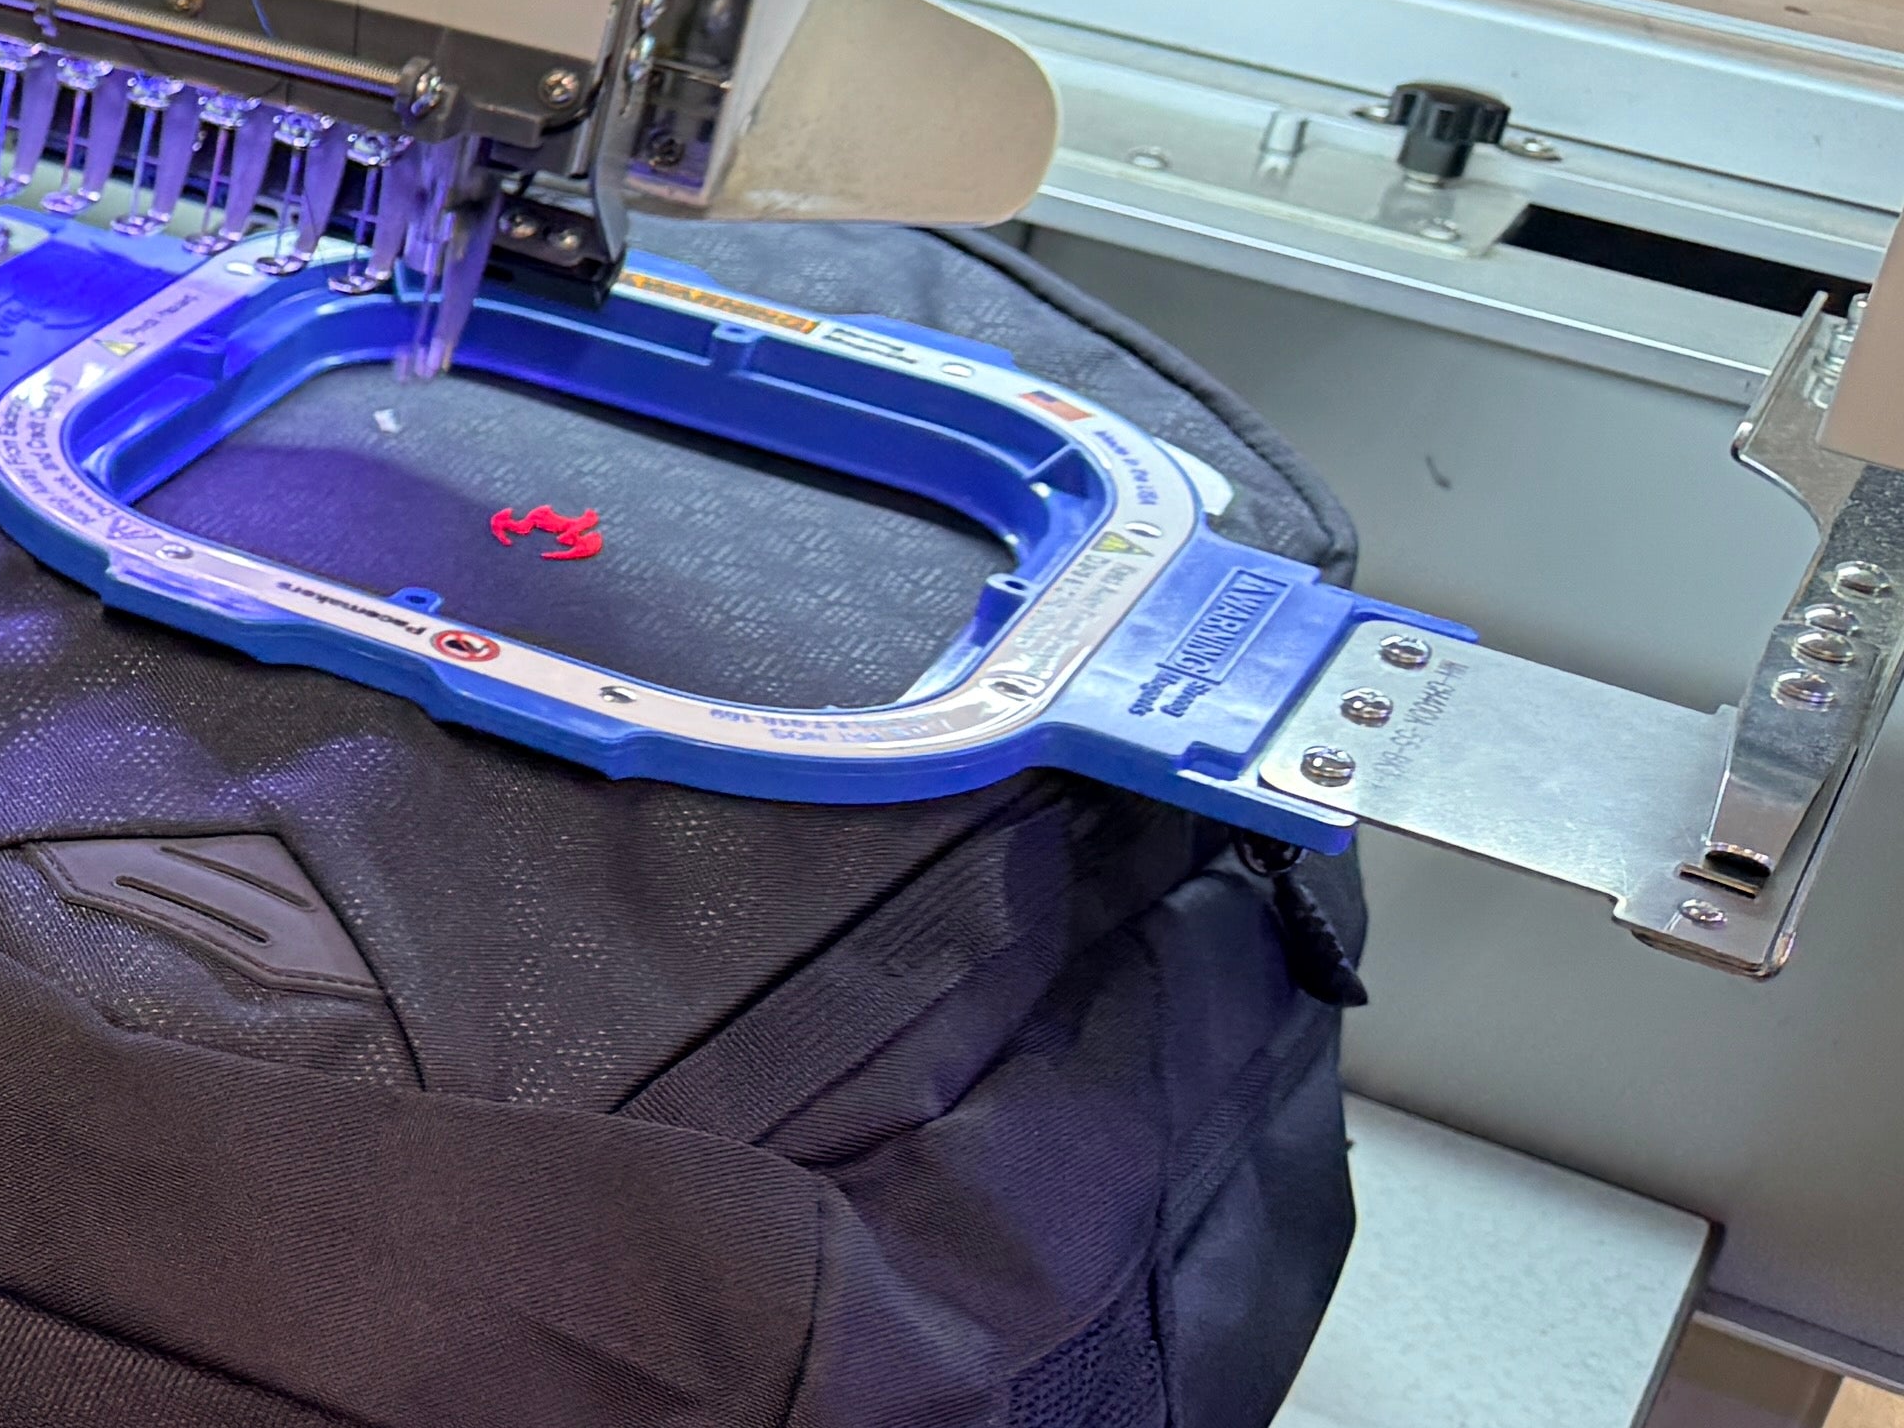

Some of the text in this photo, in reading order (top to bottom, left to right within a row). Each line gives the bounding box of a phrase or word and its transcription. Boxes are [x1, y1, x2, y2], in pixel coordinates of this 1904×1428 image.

[275, 580, 428, 636] Pacemakers
[1172, 593, 1267, 675] WARNING
[1159, 680, 1211, 718] Strong
